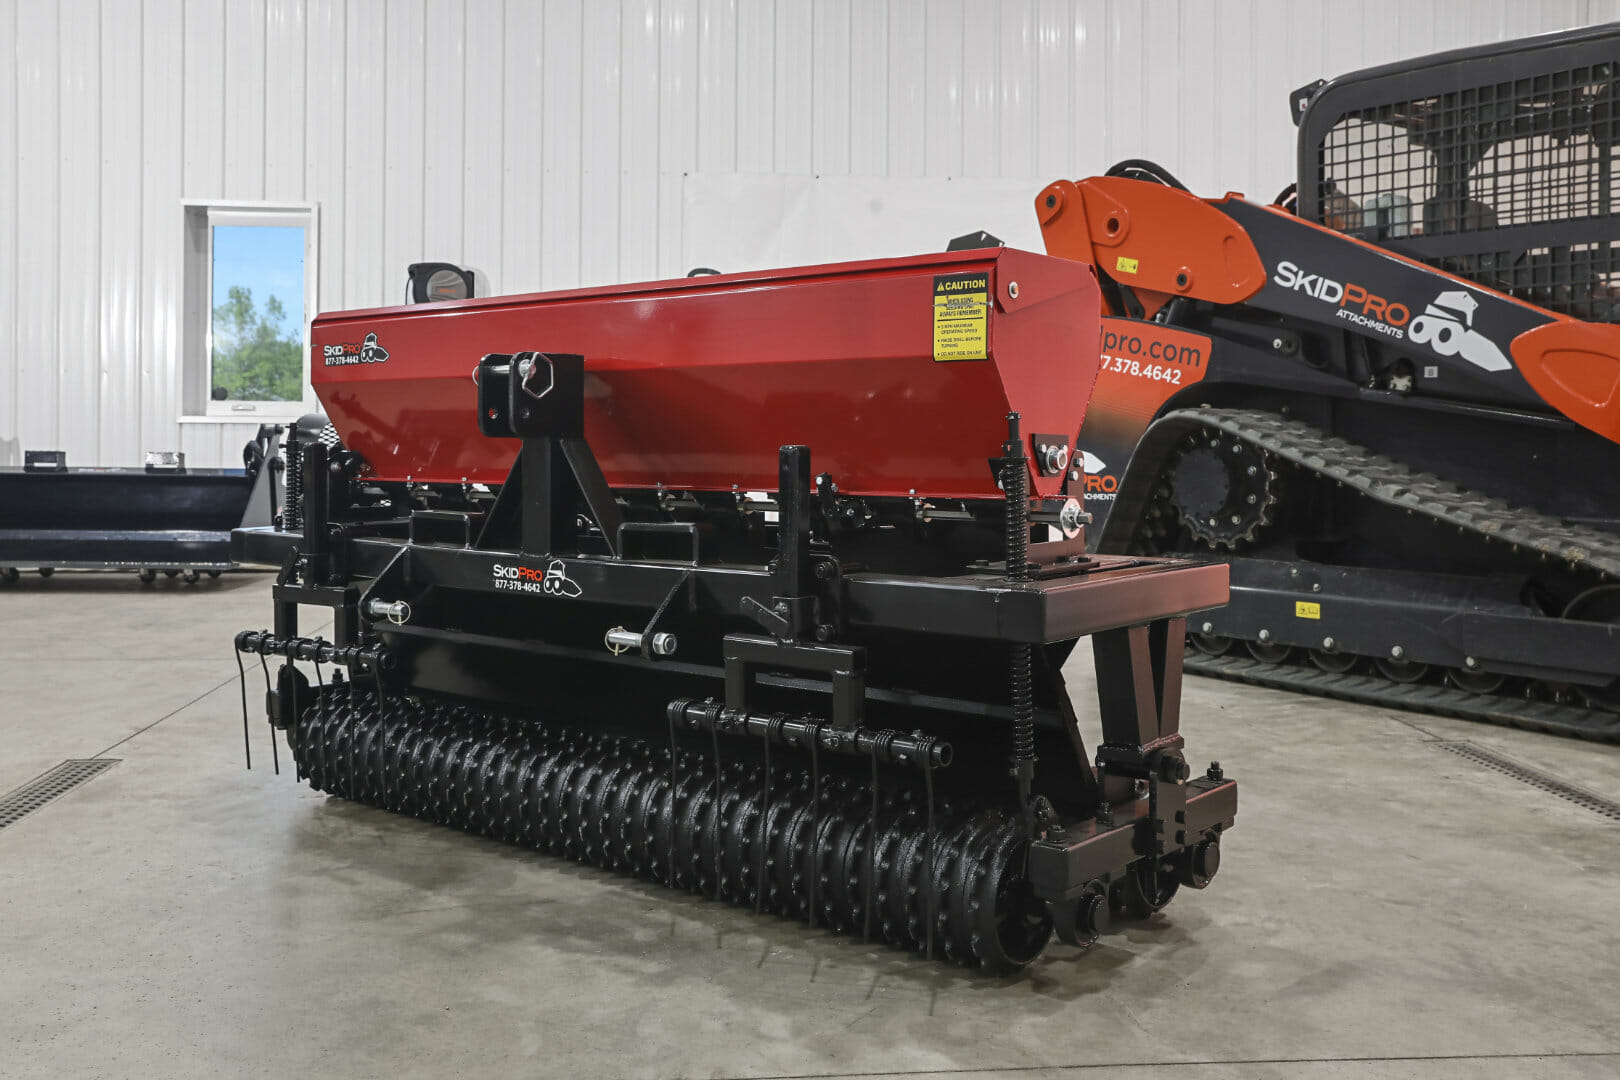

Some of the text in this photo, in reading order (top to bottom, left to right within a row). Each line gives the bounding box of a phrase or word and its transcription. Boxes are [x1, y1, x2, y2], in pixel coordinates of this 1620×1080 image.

[945, 279, 986, 291] CAUTION
[1273, 260, 1410, 327] SKIDPRO
[1336, 308, 1404, 339] ATTACHMENTS
[325, 356, 359, 366] 877-378-4642
[1100, 325, 1201, 368] pro.com
[1100, 354, 1182, 385] 7.378.4642
[495, 580, 540, 592] 877-378-4642
